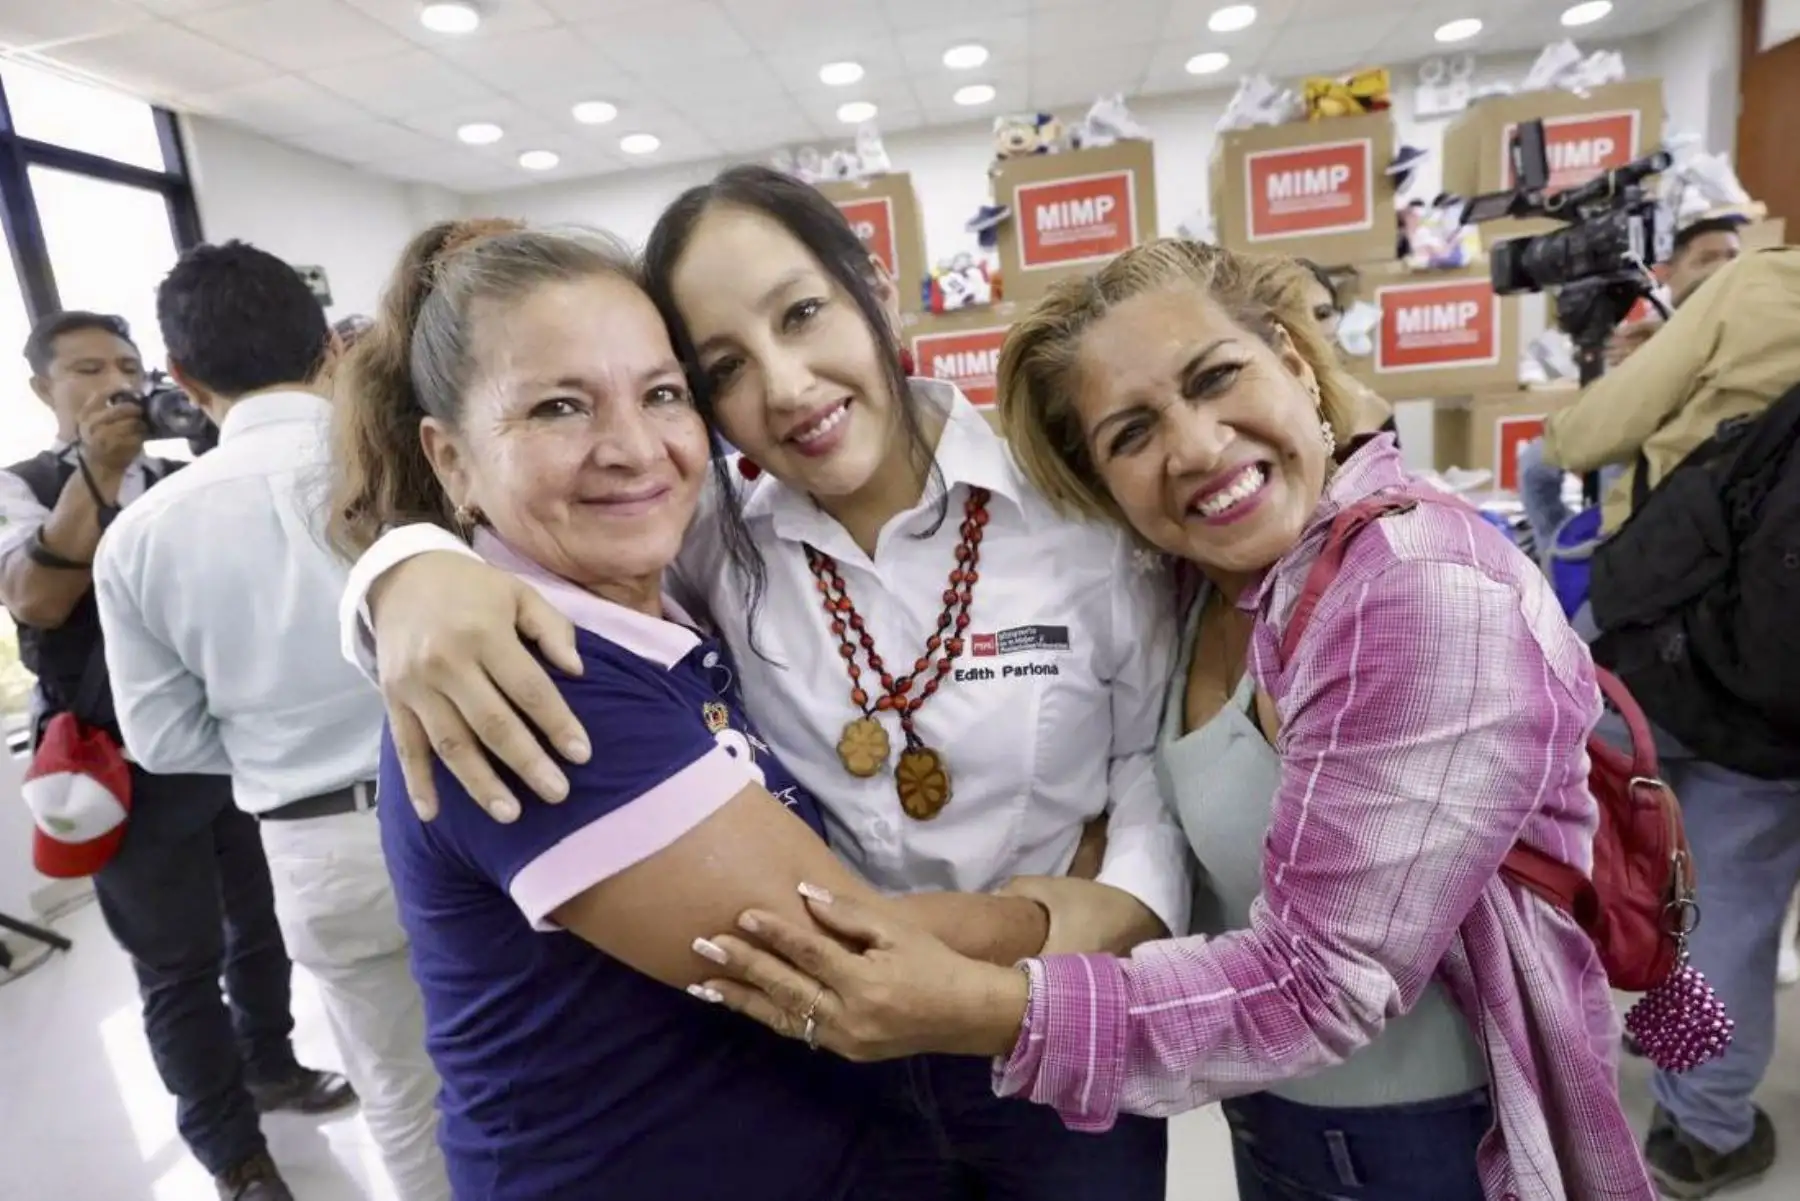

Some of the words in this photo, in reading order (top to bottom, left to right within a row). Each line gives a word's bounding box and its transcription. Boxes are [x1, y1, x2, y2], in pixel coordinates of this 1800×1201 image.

[1545, 137, 1614, 171] IMP
[1267, 164, 1349, 201] MIMP
[1036, 194, 1115, 230] MIMP
[1396, 300, 1478, 334] MIMP
[955, 668, 995, 681] Edith
[1002, 662, 1059, 678] Pariona
